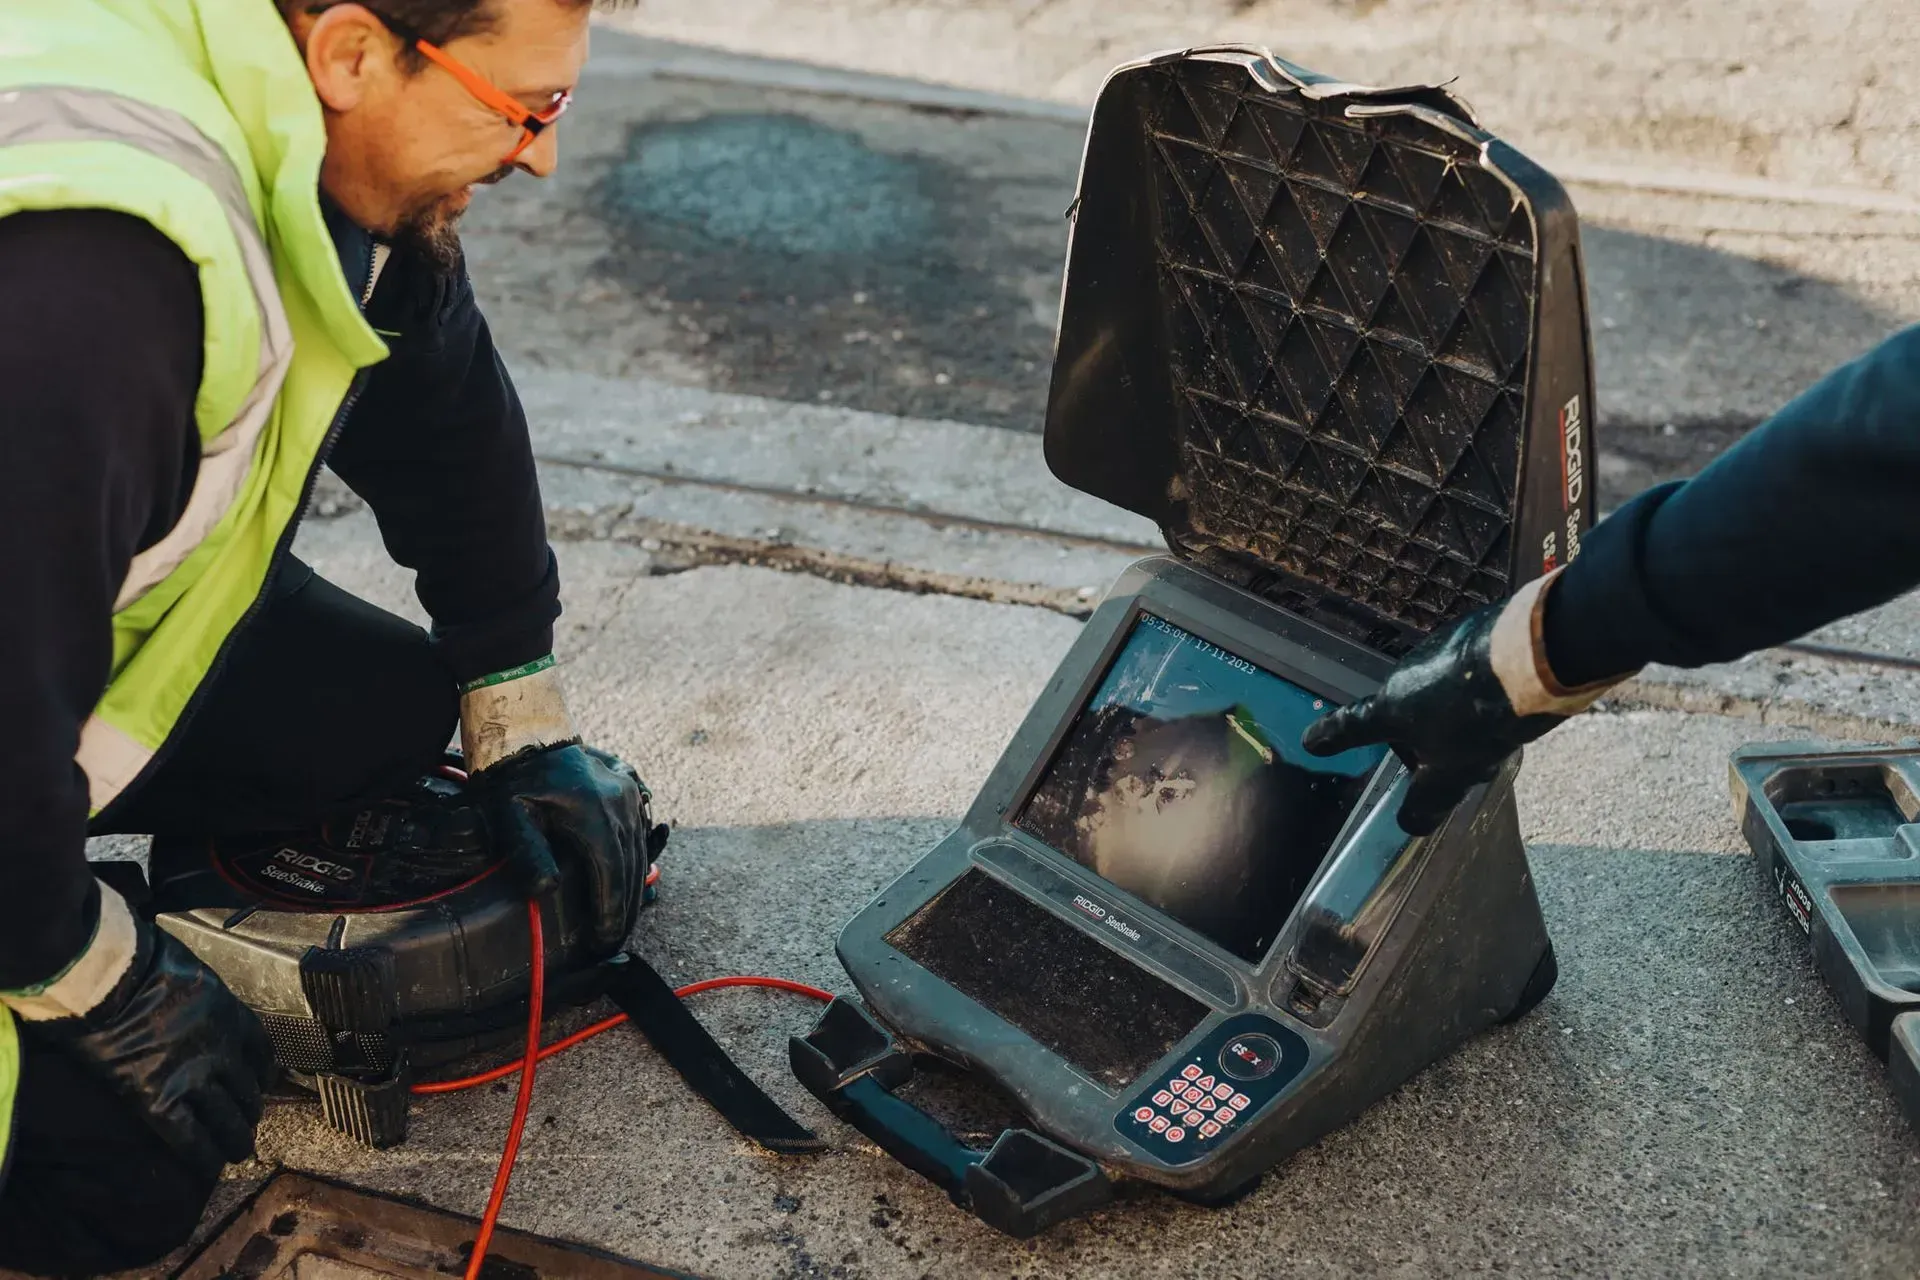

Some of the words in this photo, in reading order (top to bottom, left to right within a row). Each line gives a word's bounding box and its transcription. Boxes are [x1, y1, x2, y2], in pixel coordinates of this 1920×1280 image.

[1564, 394, 1582, 504] RIDGID
[1141, 612, 1187, 641] 05:25:04
[1194, 639, 1257, 675] 17-11-2023
[261, 864, 325, 893] SeeSnake
[274, 848, 356, 881] RIDGID
[1786, 893, 1810, 934] RIDGID
[1790, 880, 1812, 911] SCOUT
[1073, 894, 1106, 917] RIDGID
[1105, 915, 1141, 941] SeeSnake
